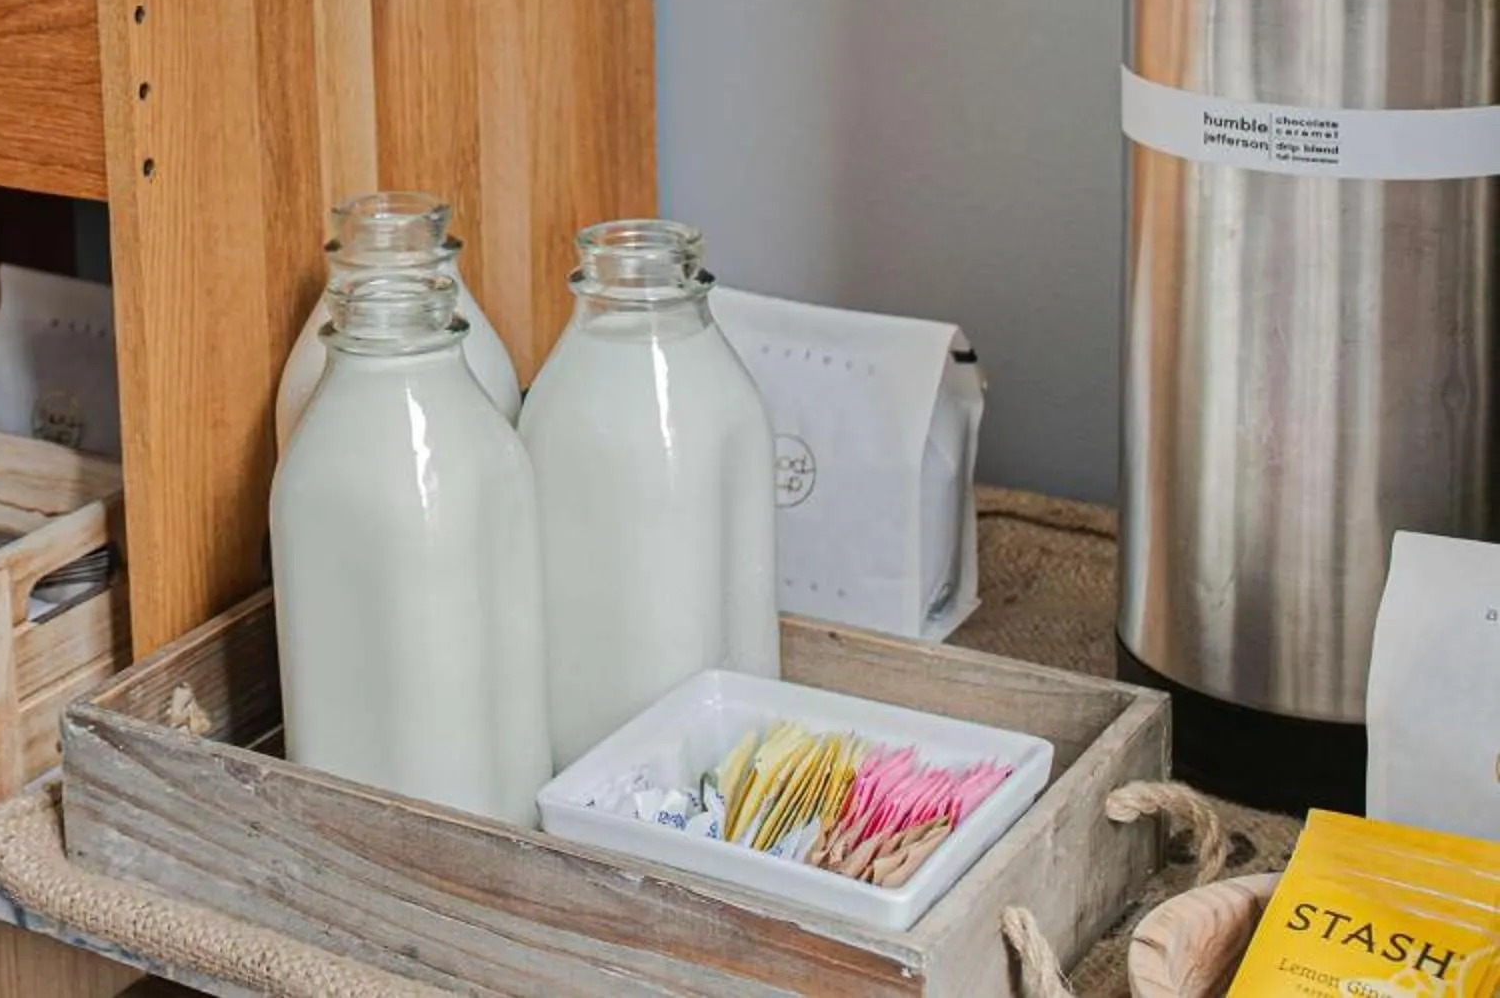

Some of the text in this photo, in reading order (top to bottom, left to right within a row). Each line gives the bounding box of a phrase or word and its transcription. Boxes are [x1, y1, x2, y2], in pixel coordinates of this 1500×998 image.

[1203, 111, 1268, 133] humble
[1275, 116, 1339, 128] chocolate
[1203, 131, 1269, 151] jefferson
[1275, 128, 1339, 139] caramel
[1286, 903, 1456, 980] STASH
[1278, 957, 1340, 989] Lemon
